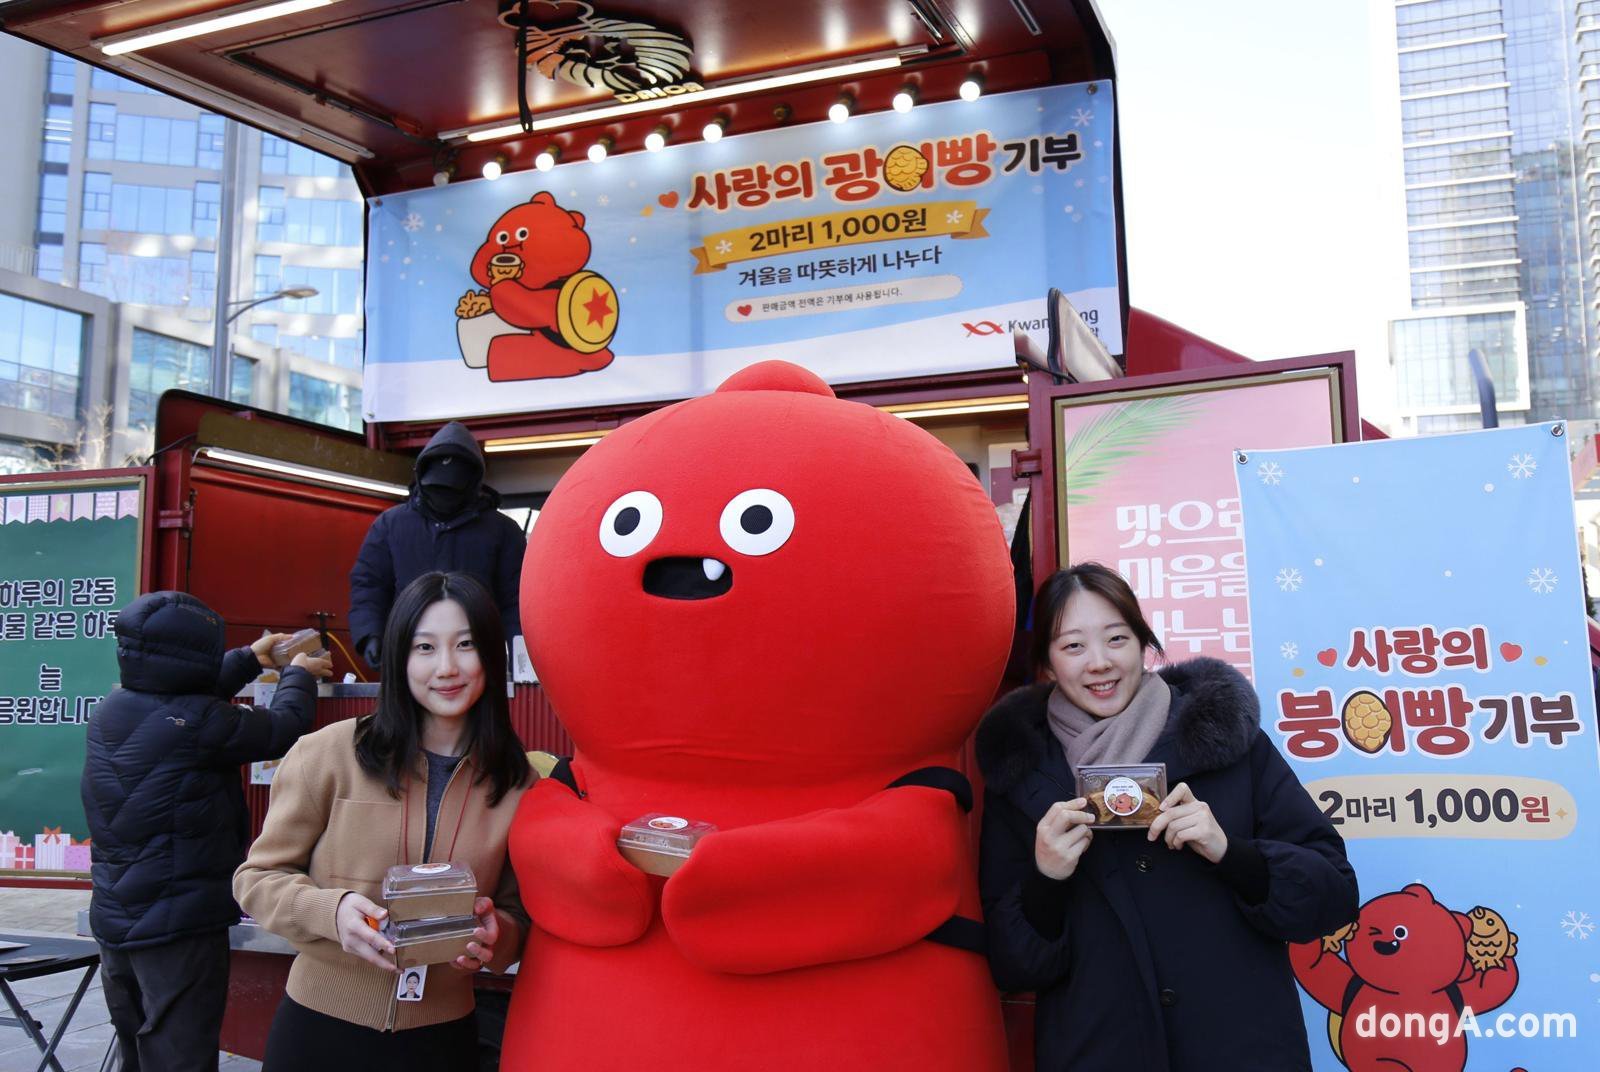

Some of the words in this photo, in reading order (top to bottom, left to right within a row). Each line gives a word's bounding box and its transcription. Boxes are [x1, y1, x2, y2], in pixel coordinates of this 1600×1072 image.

[687, 160, 813, 211] 사랑의
[1003, 133, 1081, 174] 기부
[749, 220, 815, 253] 2마리
[820, 207, 928, 244] 1,000원
[738, 265, 793, 288] 겨울을
[797, 252, 878, 281] 따뜻하게
[883, 244, 942, 270] 나누다
[827, 293, 854, 305] 기부에
[856, 287, 903, 301] 사용됩니다.
[1008, 308, 1099, 333] Kwanng
[0, 579, 64, 608] 하루의
[70, 576, 116, 607] 감동
[33, 611, 77, 640] 같은
[1347, 626, 1489, 675] 사랑의
[40, 663, 62, 692] 늘
[1478, 694, 1581, 746] 기부
[1318, 789, 1397, 825] 2마리
[1405, 787, 1551, 829] 1,000원
